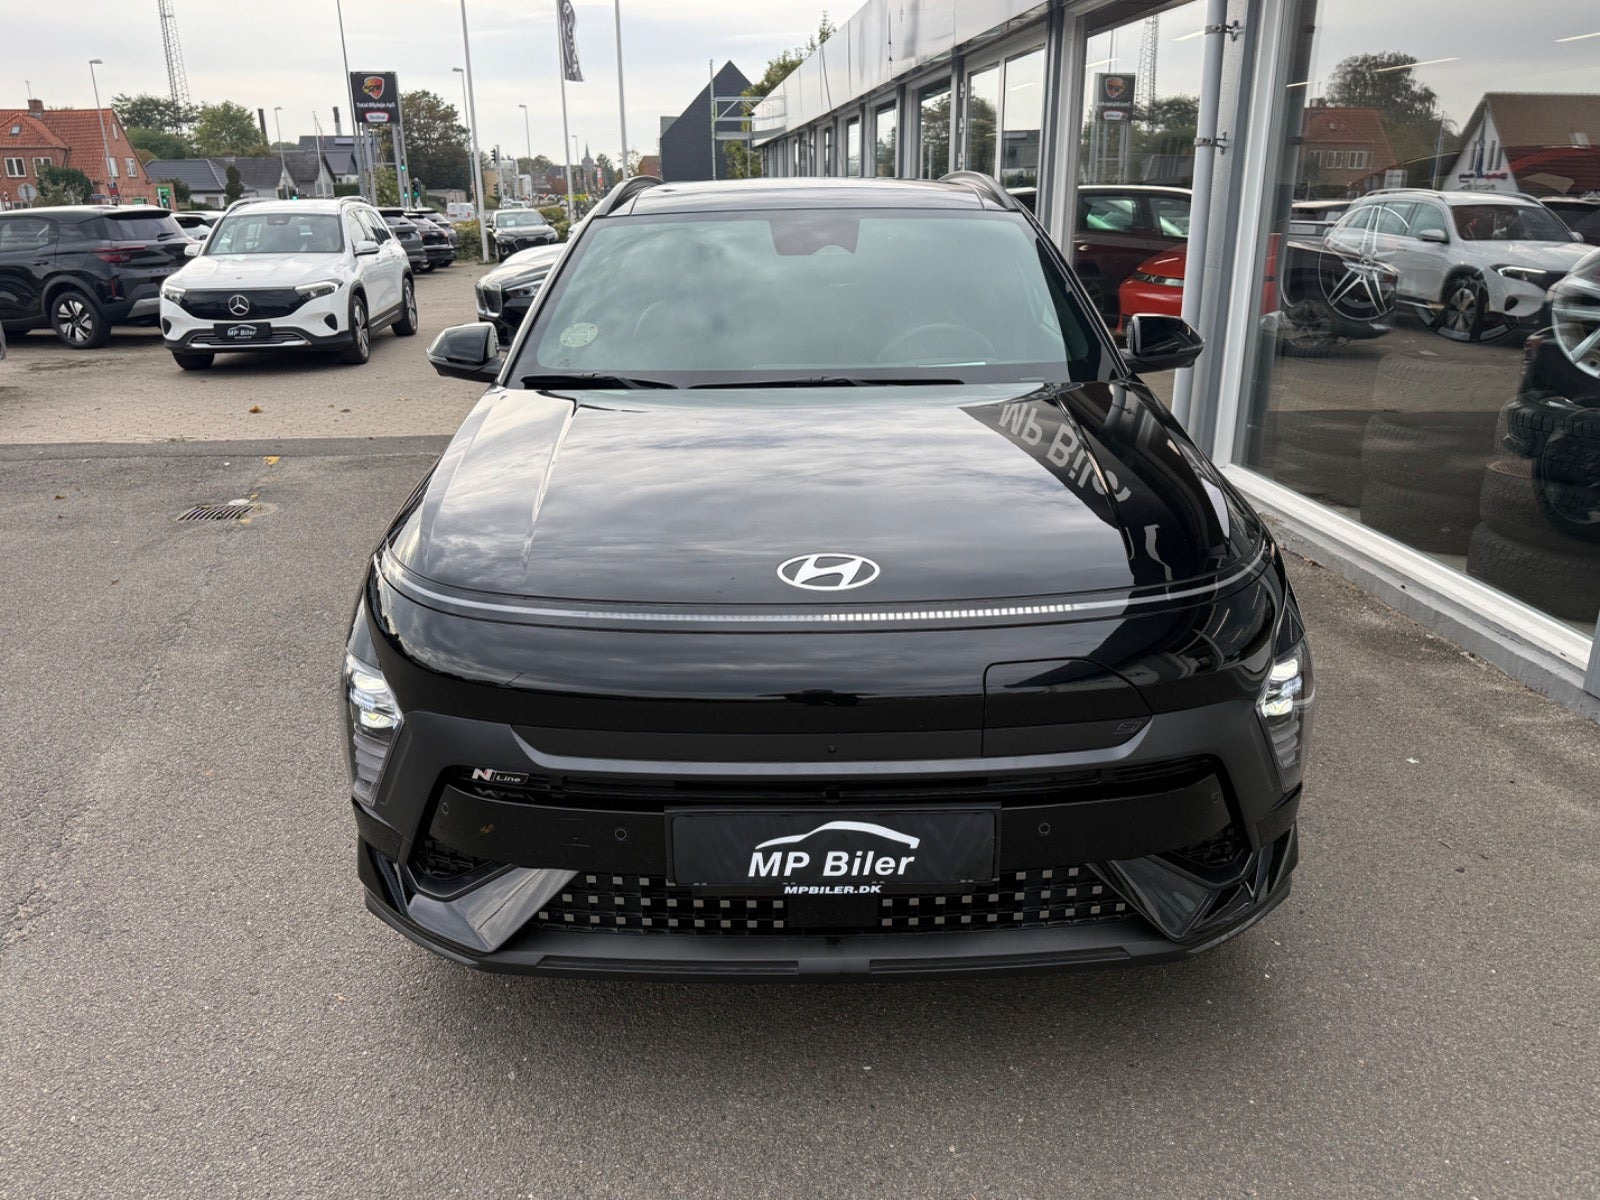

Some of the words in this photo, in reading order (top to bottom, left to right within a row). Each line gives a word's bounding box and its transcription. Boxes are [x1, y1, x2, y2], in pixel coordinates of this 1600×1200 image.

[472, 768, 494, 782] N
[748, 851, 810, 878] MP
[822, 850, 916, 877] Biler
[784, 884, 883, 895] MPBILER.DK
